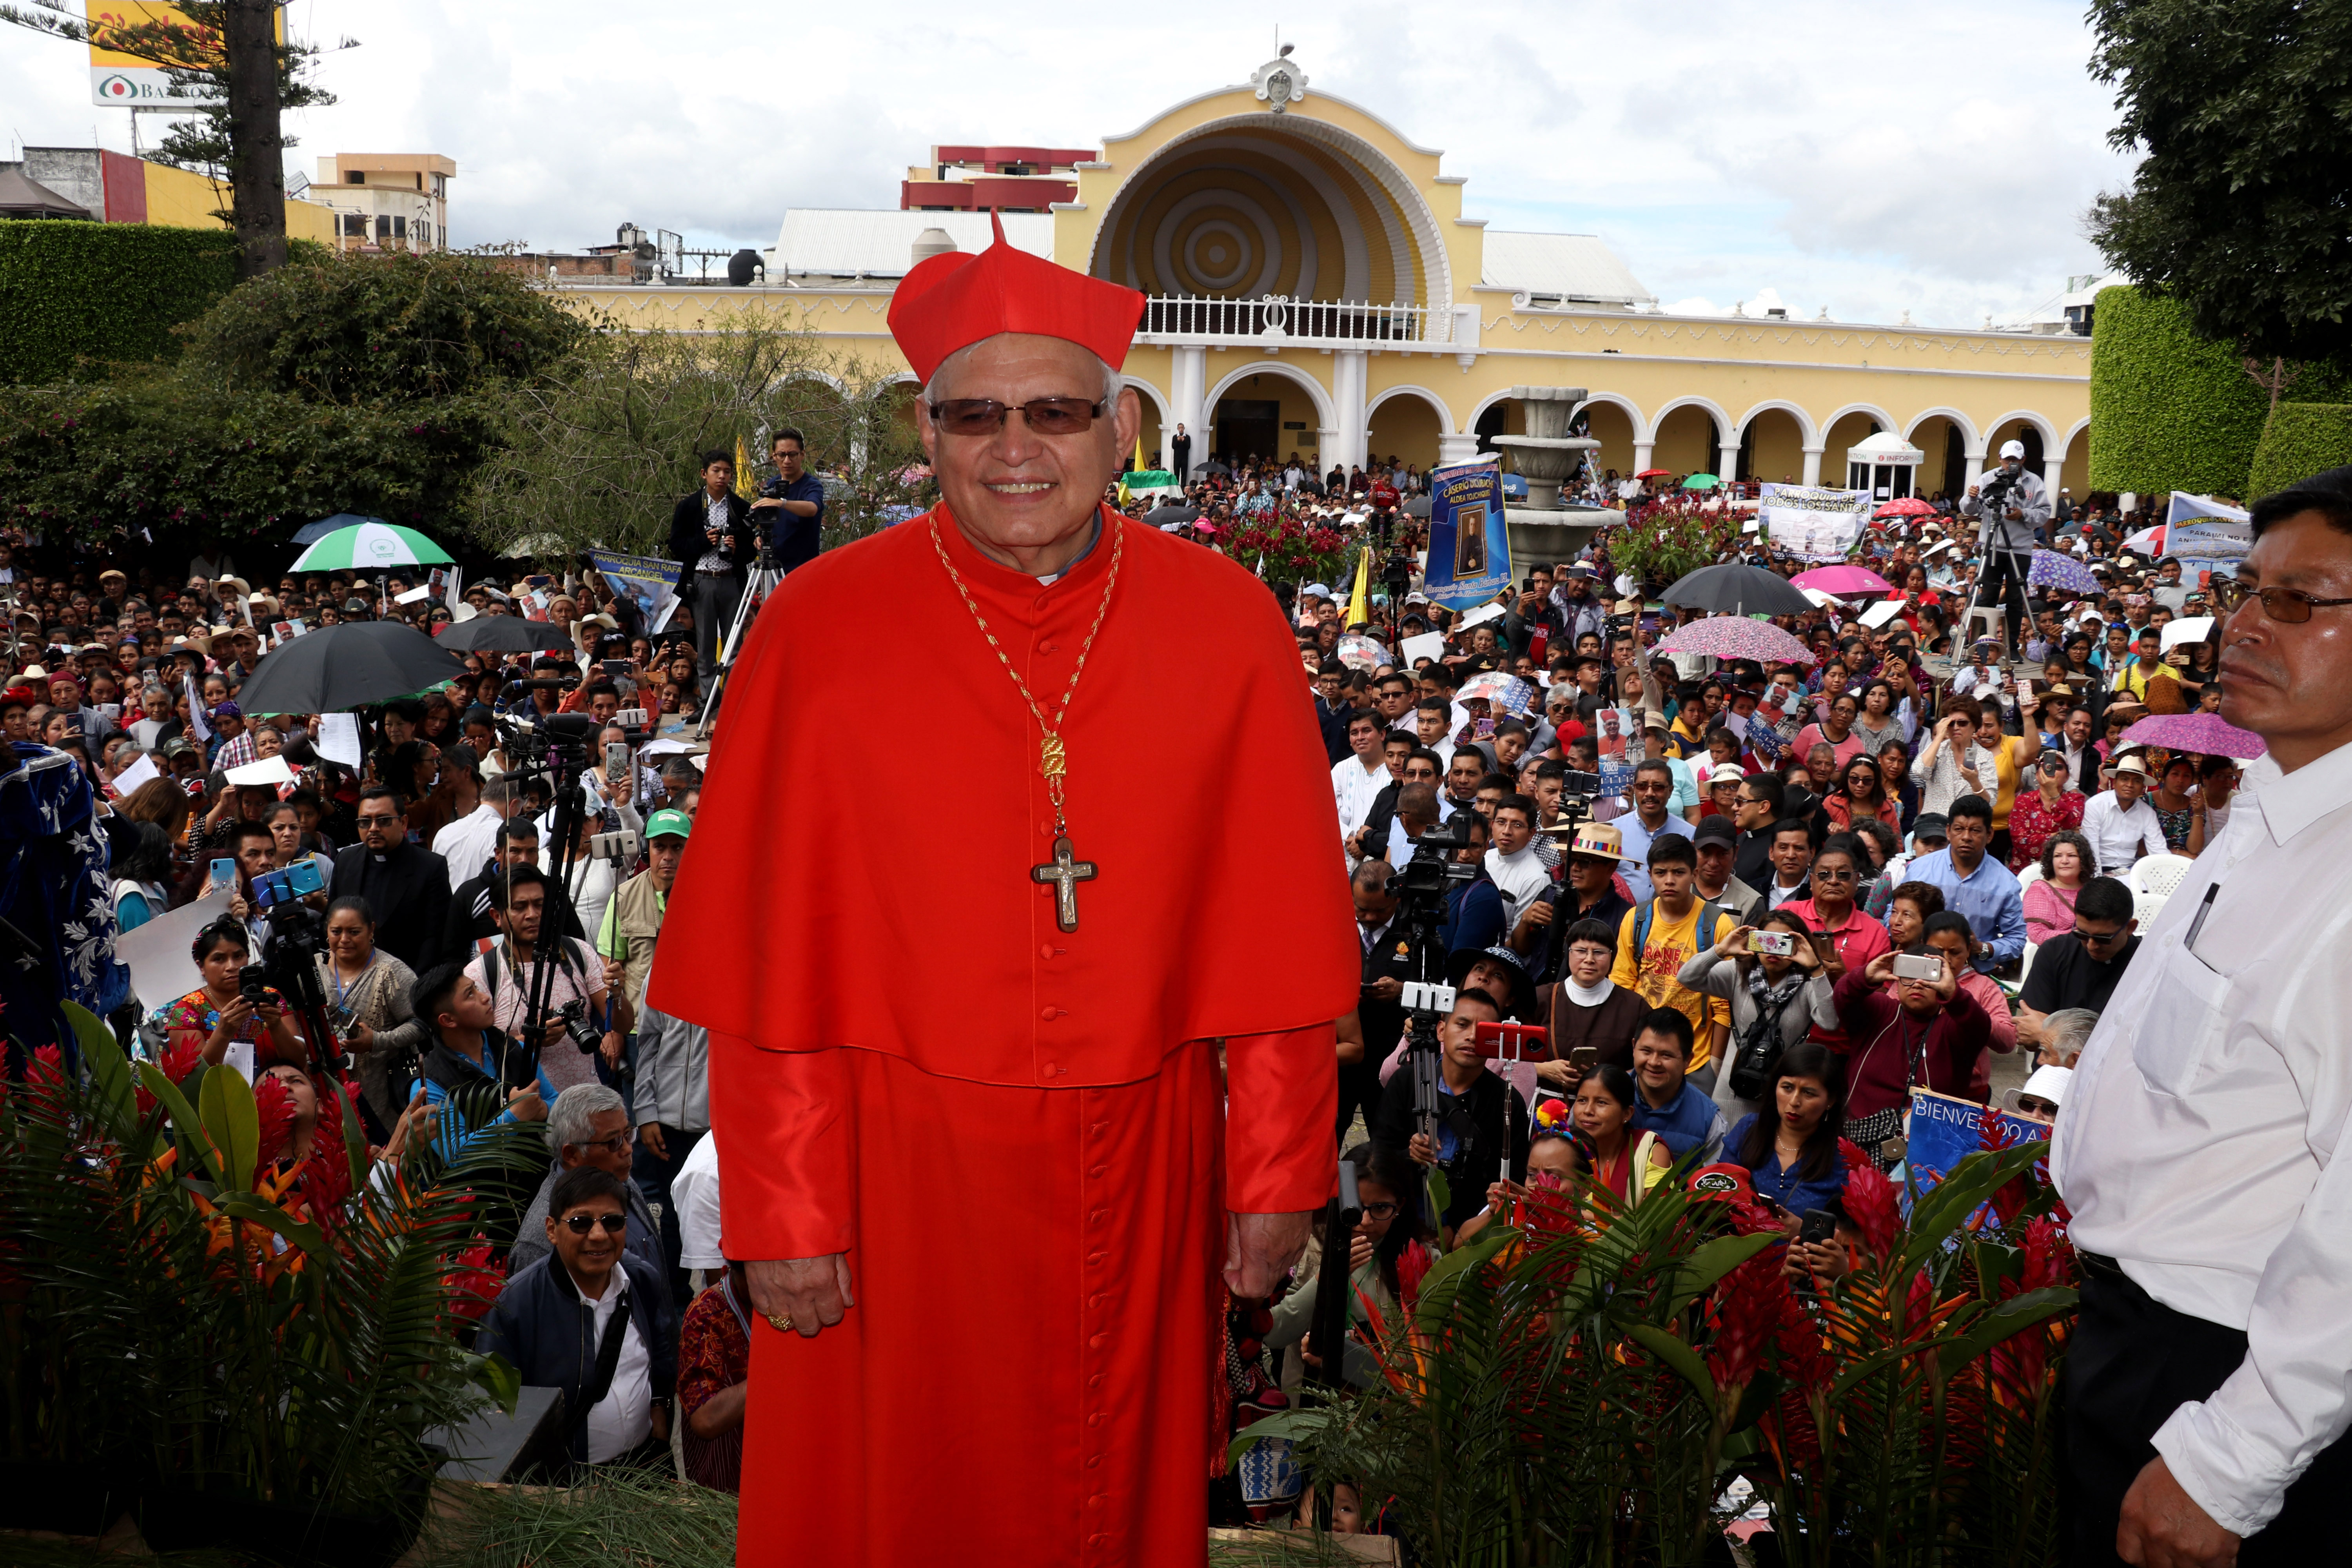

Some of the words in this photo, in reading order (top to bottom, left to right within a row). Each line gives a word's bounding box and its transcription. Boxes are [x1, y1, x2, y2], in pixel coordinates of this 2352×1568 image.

[1434, 469, 1464, 482] COMUNIDAD
[1443, 479, 1469, 498] CASERÍO
[1774, 486, 1838, 501] PARROQUIA
[1841, 493, 1857, 502] DE
[1450, 495, 1466, 504] ALDEA
[1763, 496, 1799, 509] TODOS
[1802, 500, 1822, 510] LOS
[1825, 501, 1869, 514] SANTOS
[2175, 516, 2212, 529] PARROQUIA
[594, 553, 642, 567] PARROQUIA
[643, 560, 659, 570] SAN
[661, 564, 682, 574] RAFA
[618, 566, 664, 580] ARCANGEL
[1457, 581, 1477, 591] Santa
[1603, 761, 1618, 772] 2020
[1642, 946, 1681, 963] RANE
[2025, 1129, 2037, 1143] A
